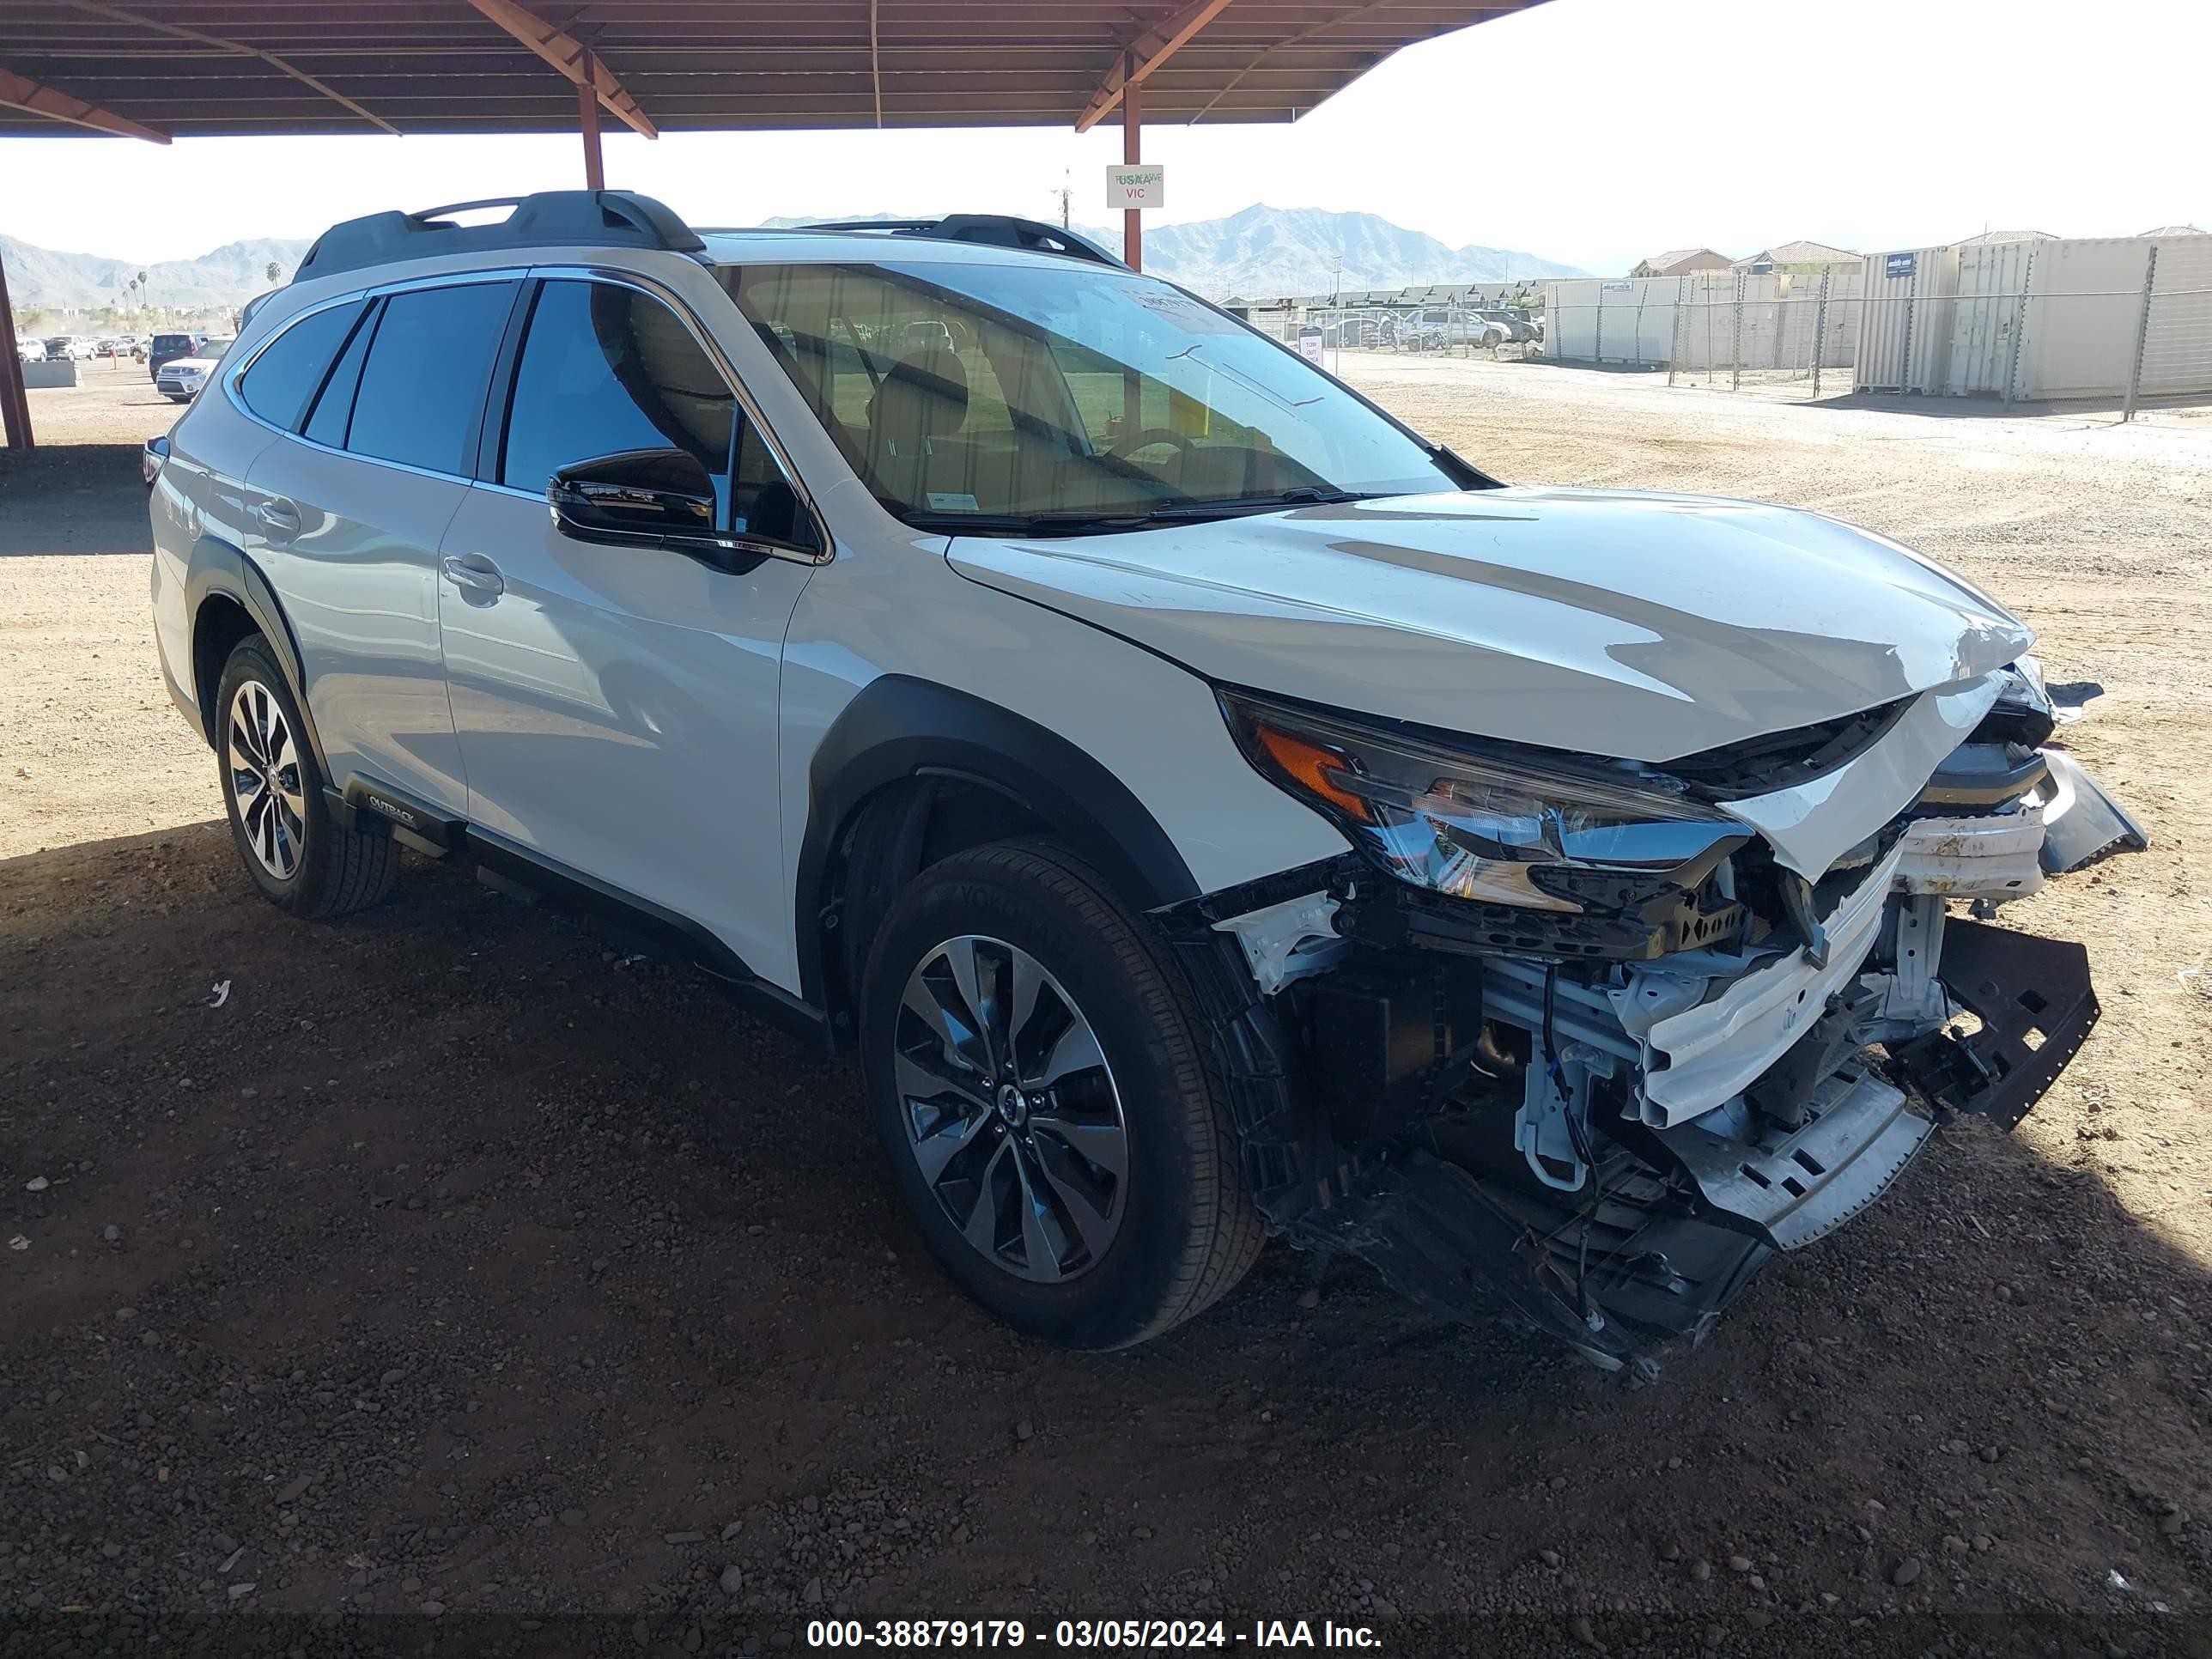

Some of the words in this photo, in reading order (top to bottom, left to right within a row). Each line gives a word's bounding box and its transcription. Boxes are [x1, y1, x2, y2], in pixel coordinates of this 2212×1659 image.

[1120, 175, 1151, 185] USAA
[1127, 188, 1145, 198] VIC
[369, 796, 414, 822] OUTBACK
